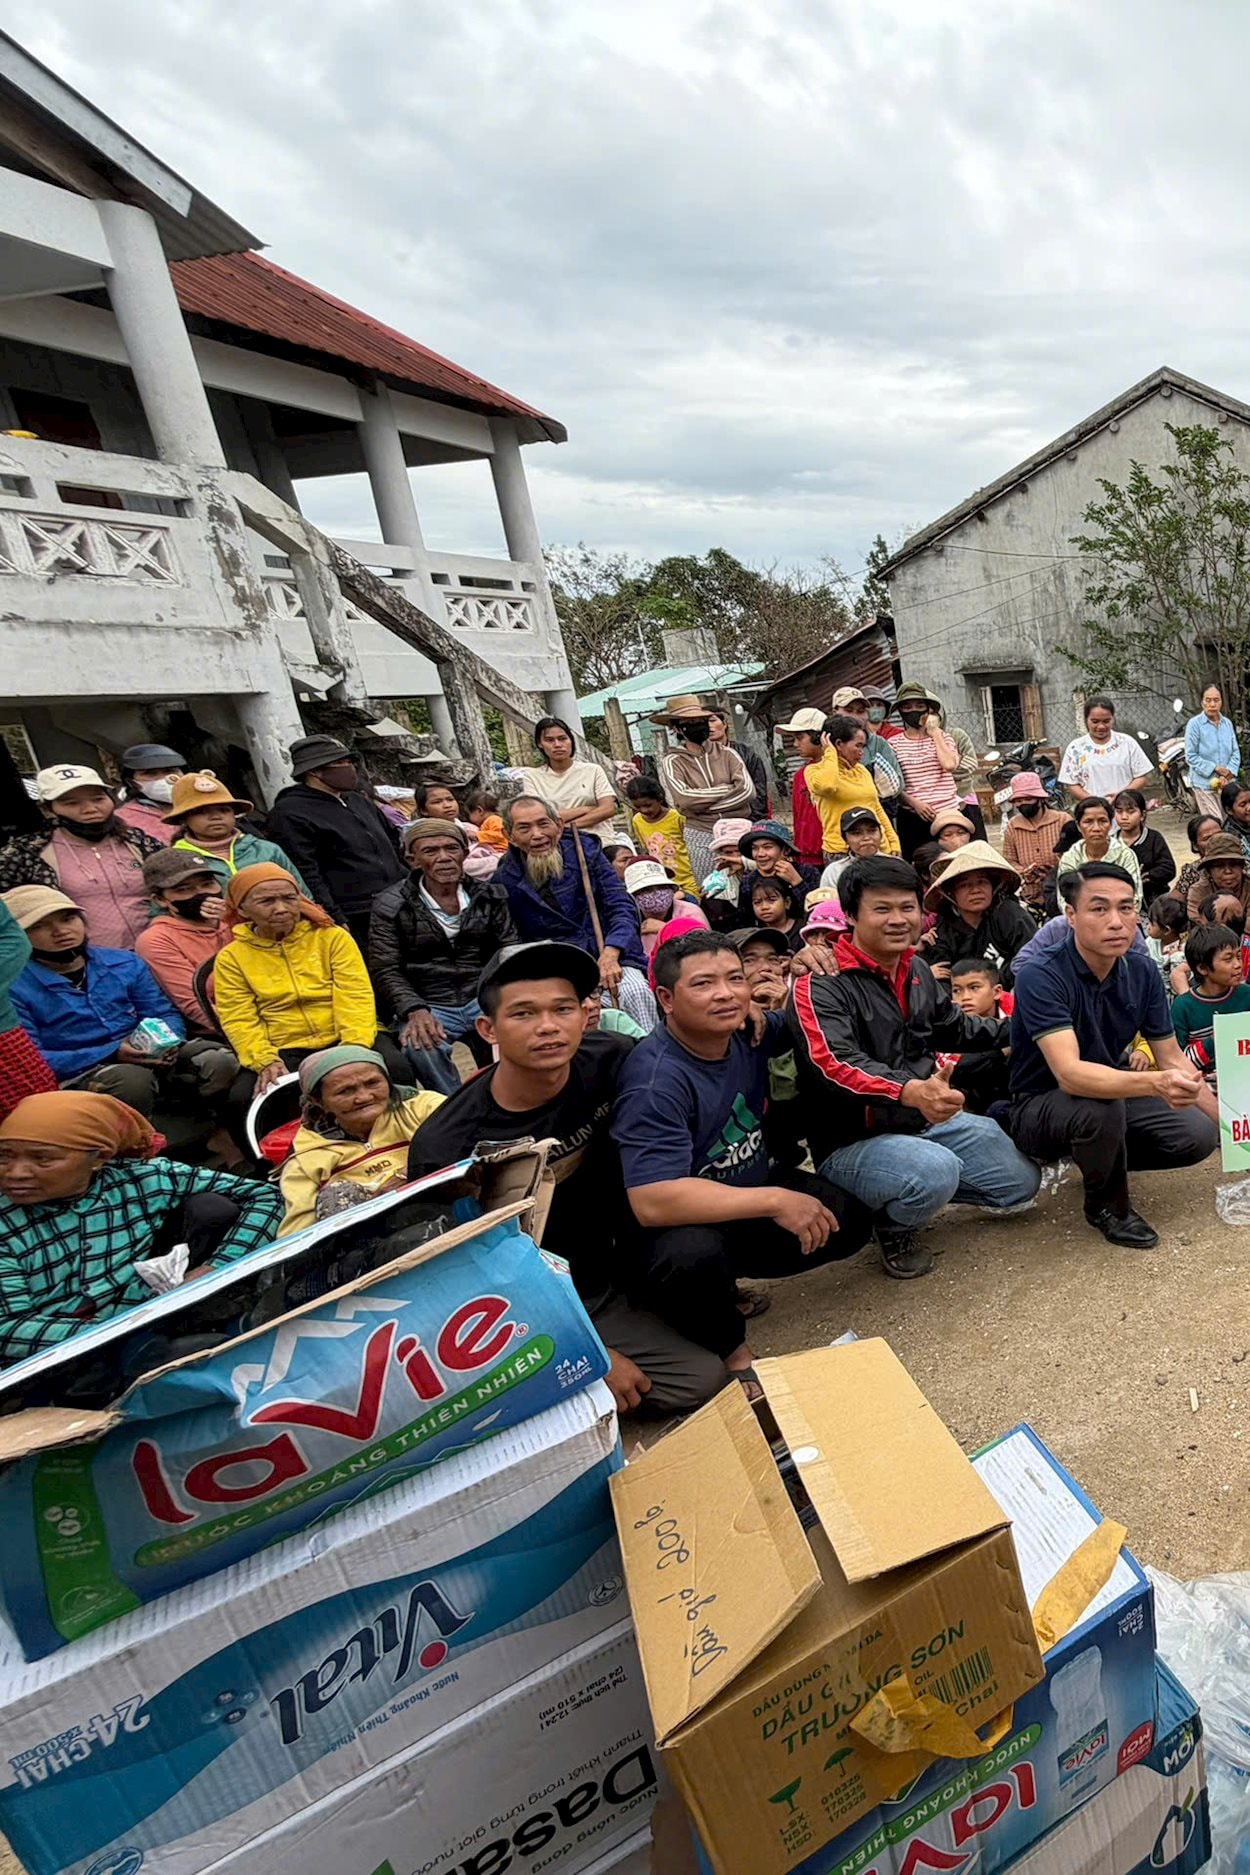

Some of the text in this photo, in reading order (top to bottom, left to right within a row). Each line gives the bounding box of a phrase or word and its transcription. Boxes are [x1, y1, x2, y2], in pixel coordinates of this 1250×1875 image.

[555, 1358, 571, 1375] 24
[557, 1355, 589, 1380] CHAI
[395, 1396, 469, 1448] THIÊN
[476, 1347, 543, 1400] NHIÊN
[910, 1620, 965, 1669] SƠN
[89, 1694, 151, 1748] 24
[15, 1738, 93, 1789] CHAI
[528, 1776, 565, 1807] trong
[902, 1769, 979, 1829] KHOÁNG
